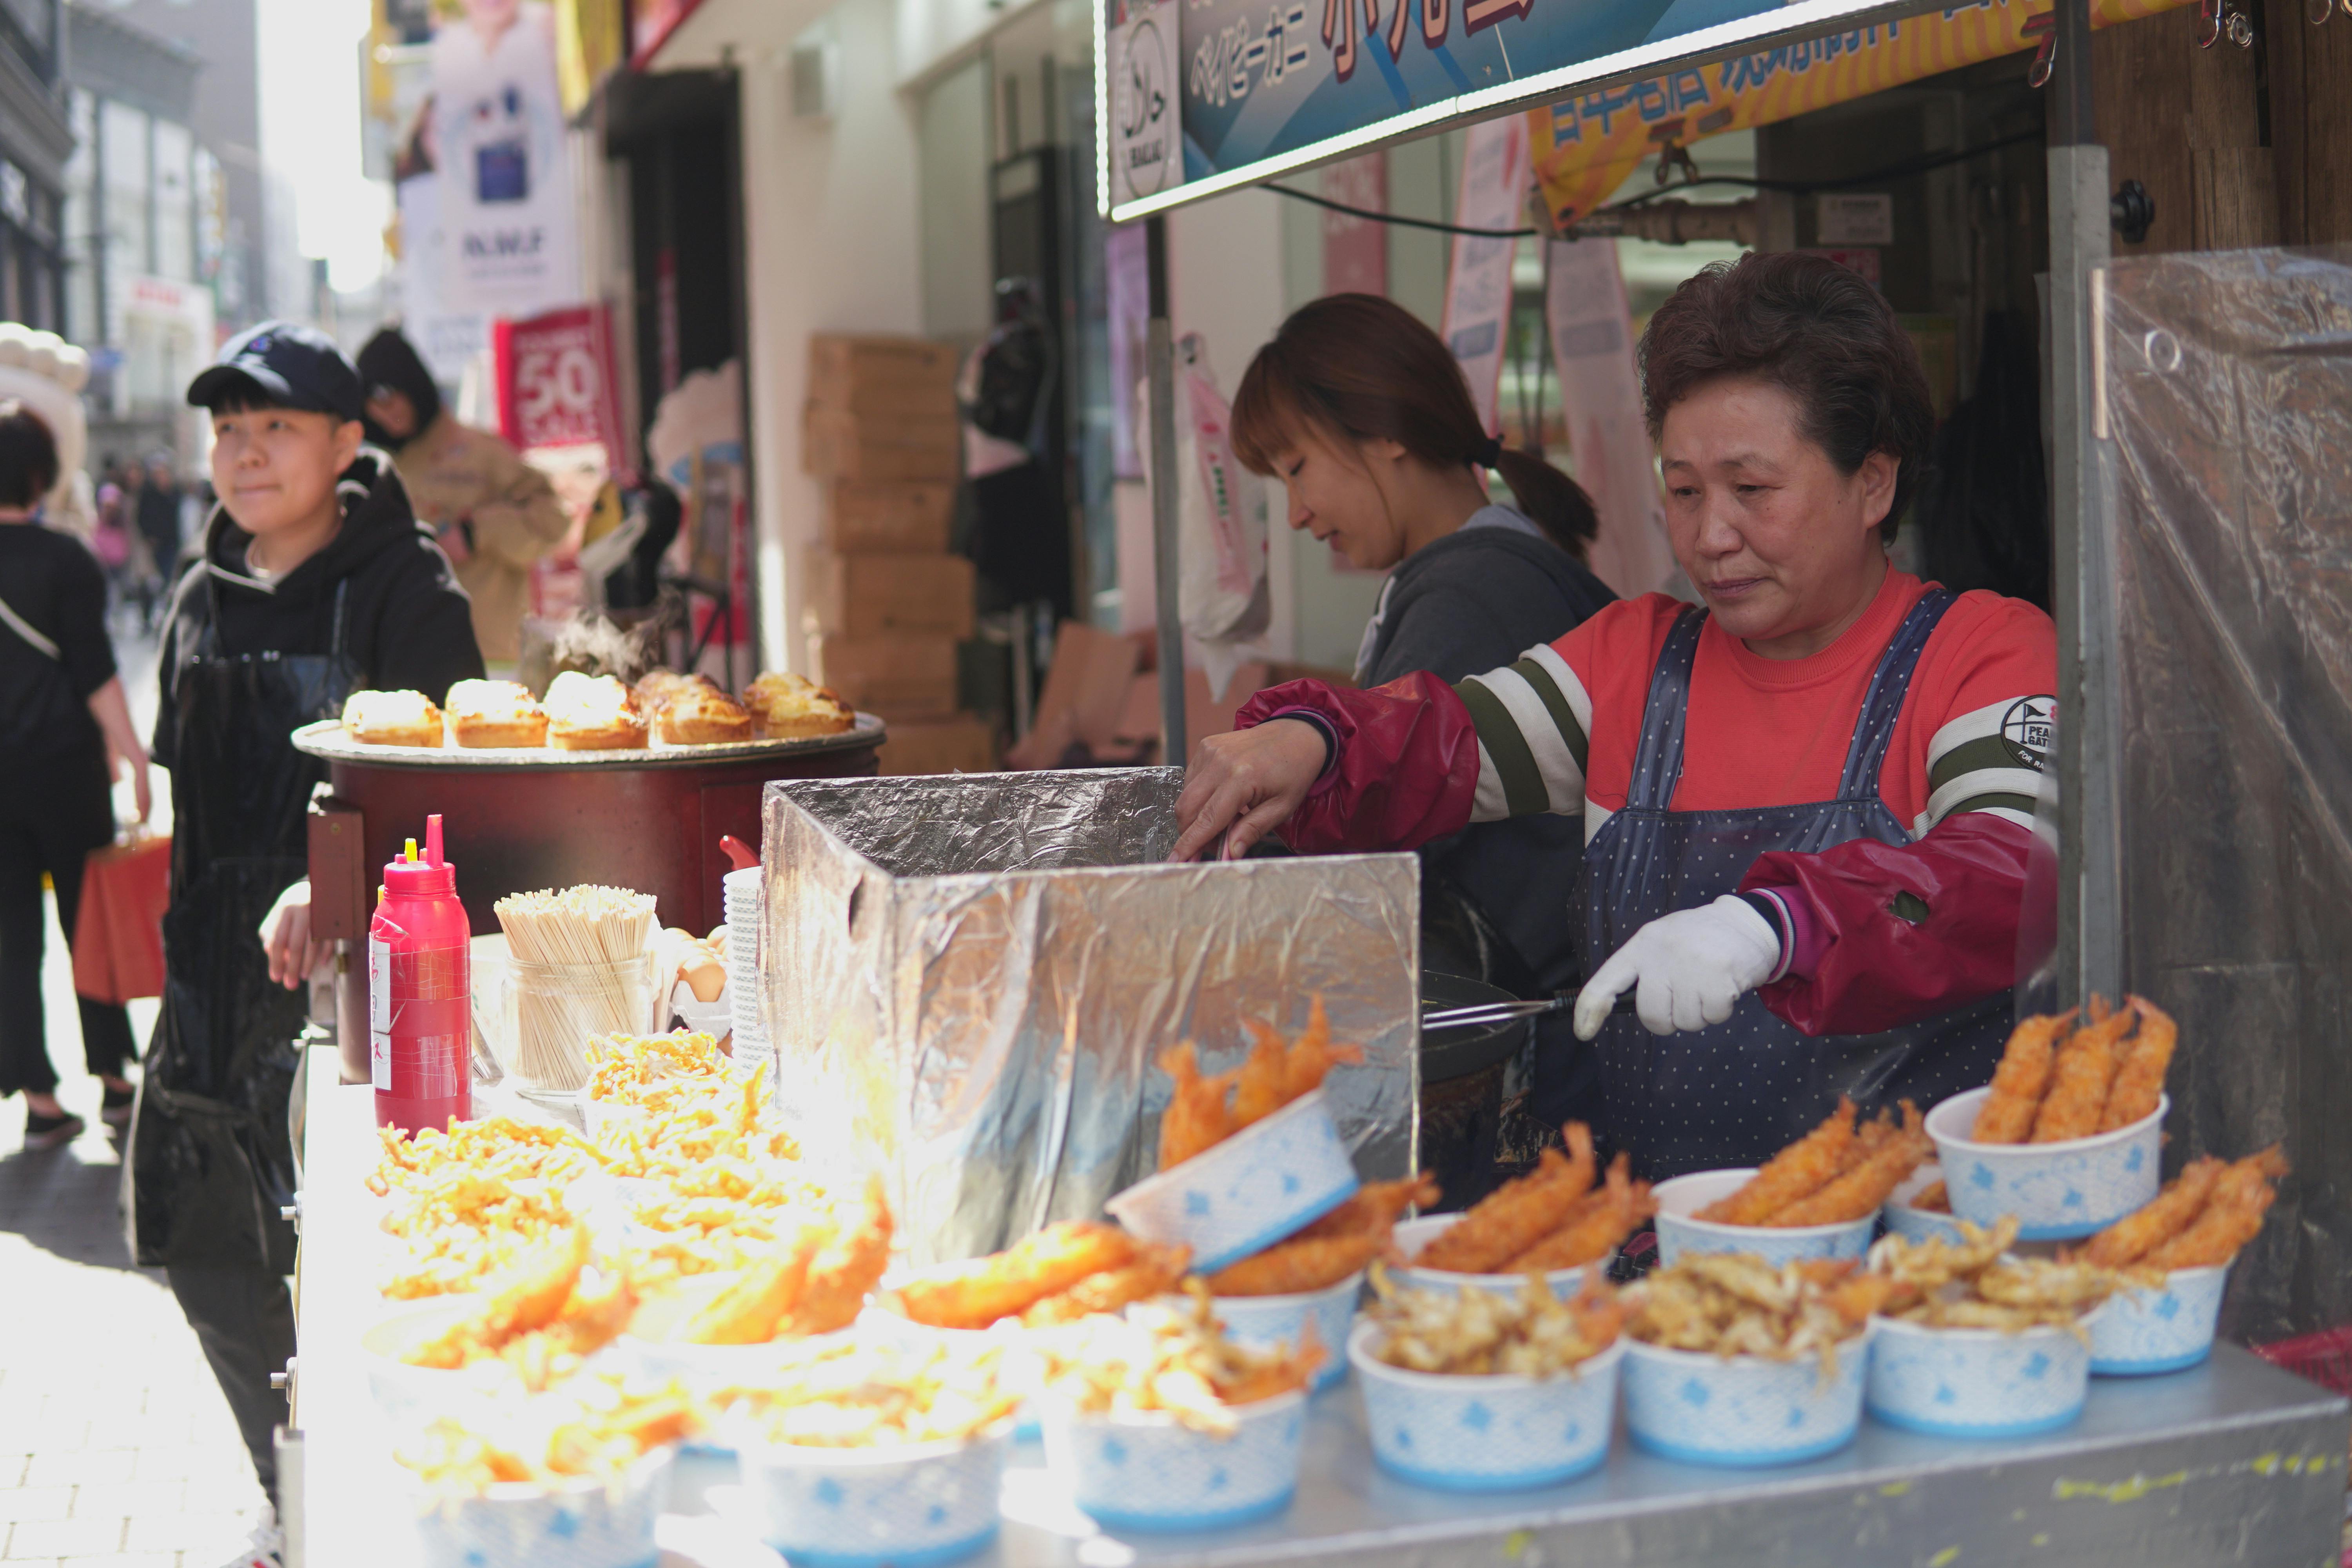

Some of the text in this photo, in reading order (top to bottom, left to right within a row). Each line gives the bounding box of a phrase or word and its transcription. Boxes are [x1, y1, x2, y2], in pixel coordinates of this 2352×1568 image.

[517, 347, 600, 419] 50
[2029, 726, 2050, 738] PEA
[2028, 736, 2049, 747] GAT
[2018, 750, 2045, 769] FOR RA
